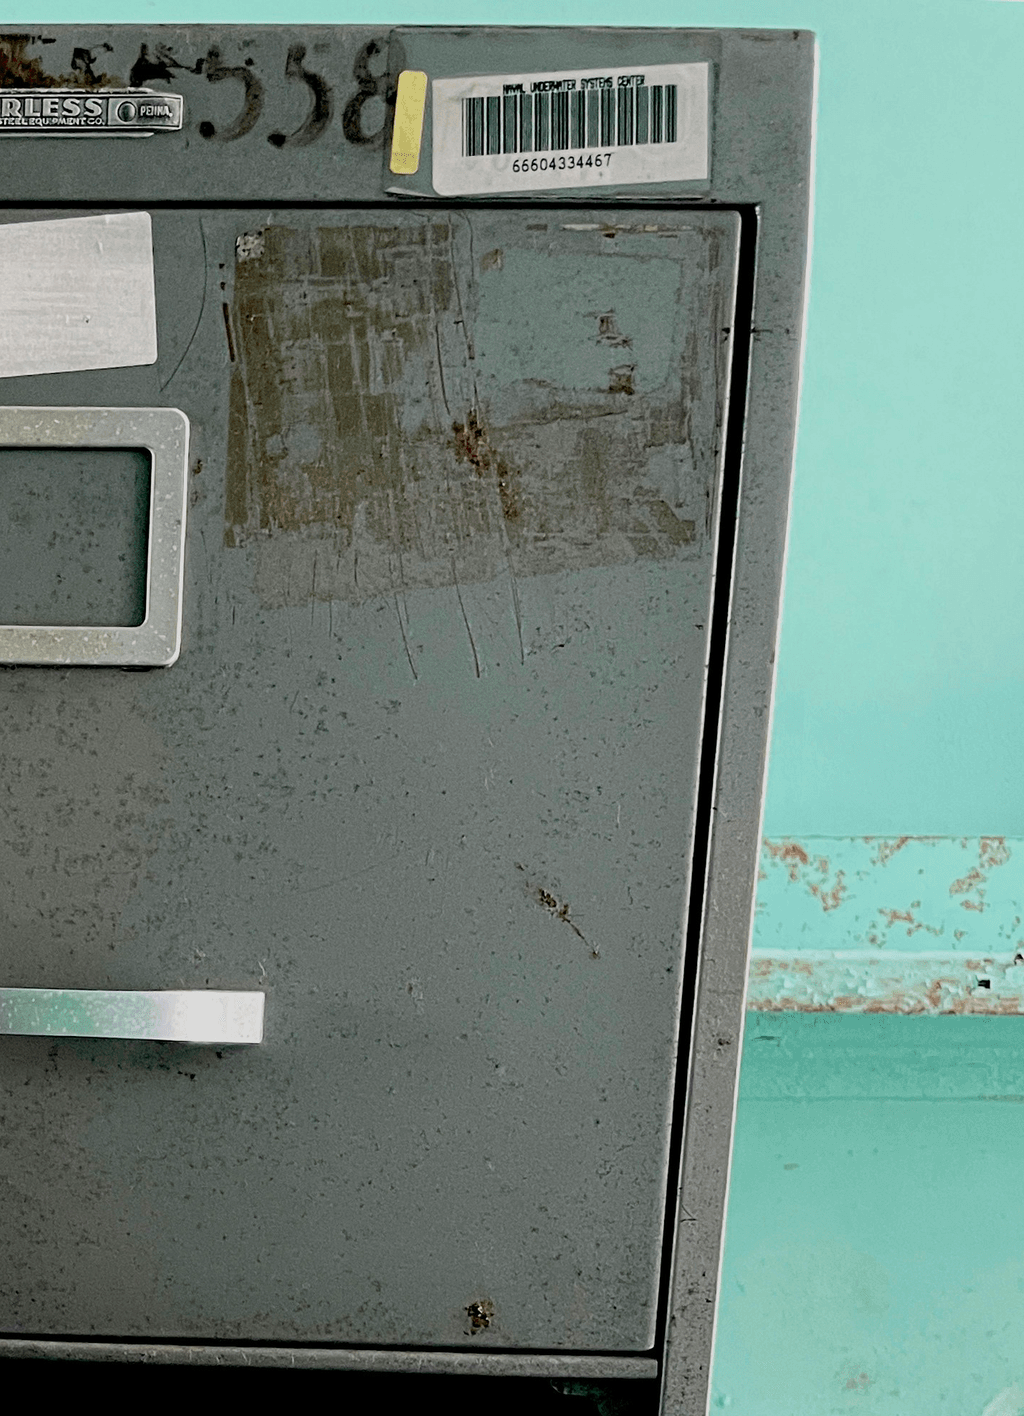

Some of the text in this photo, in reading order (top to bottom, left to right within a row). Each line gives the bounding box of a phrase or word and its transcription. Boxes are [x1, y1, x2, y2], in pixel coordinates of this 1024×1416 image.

[530, 79, 576, 93] UNDERWATER
[581, 76, 613, 90] SYSTEMS
[617, 74, 645, 87] CENTER
[512, 153, 613, 173] 66604334467
